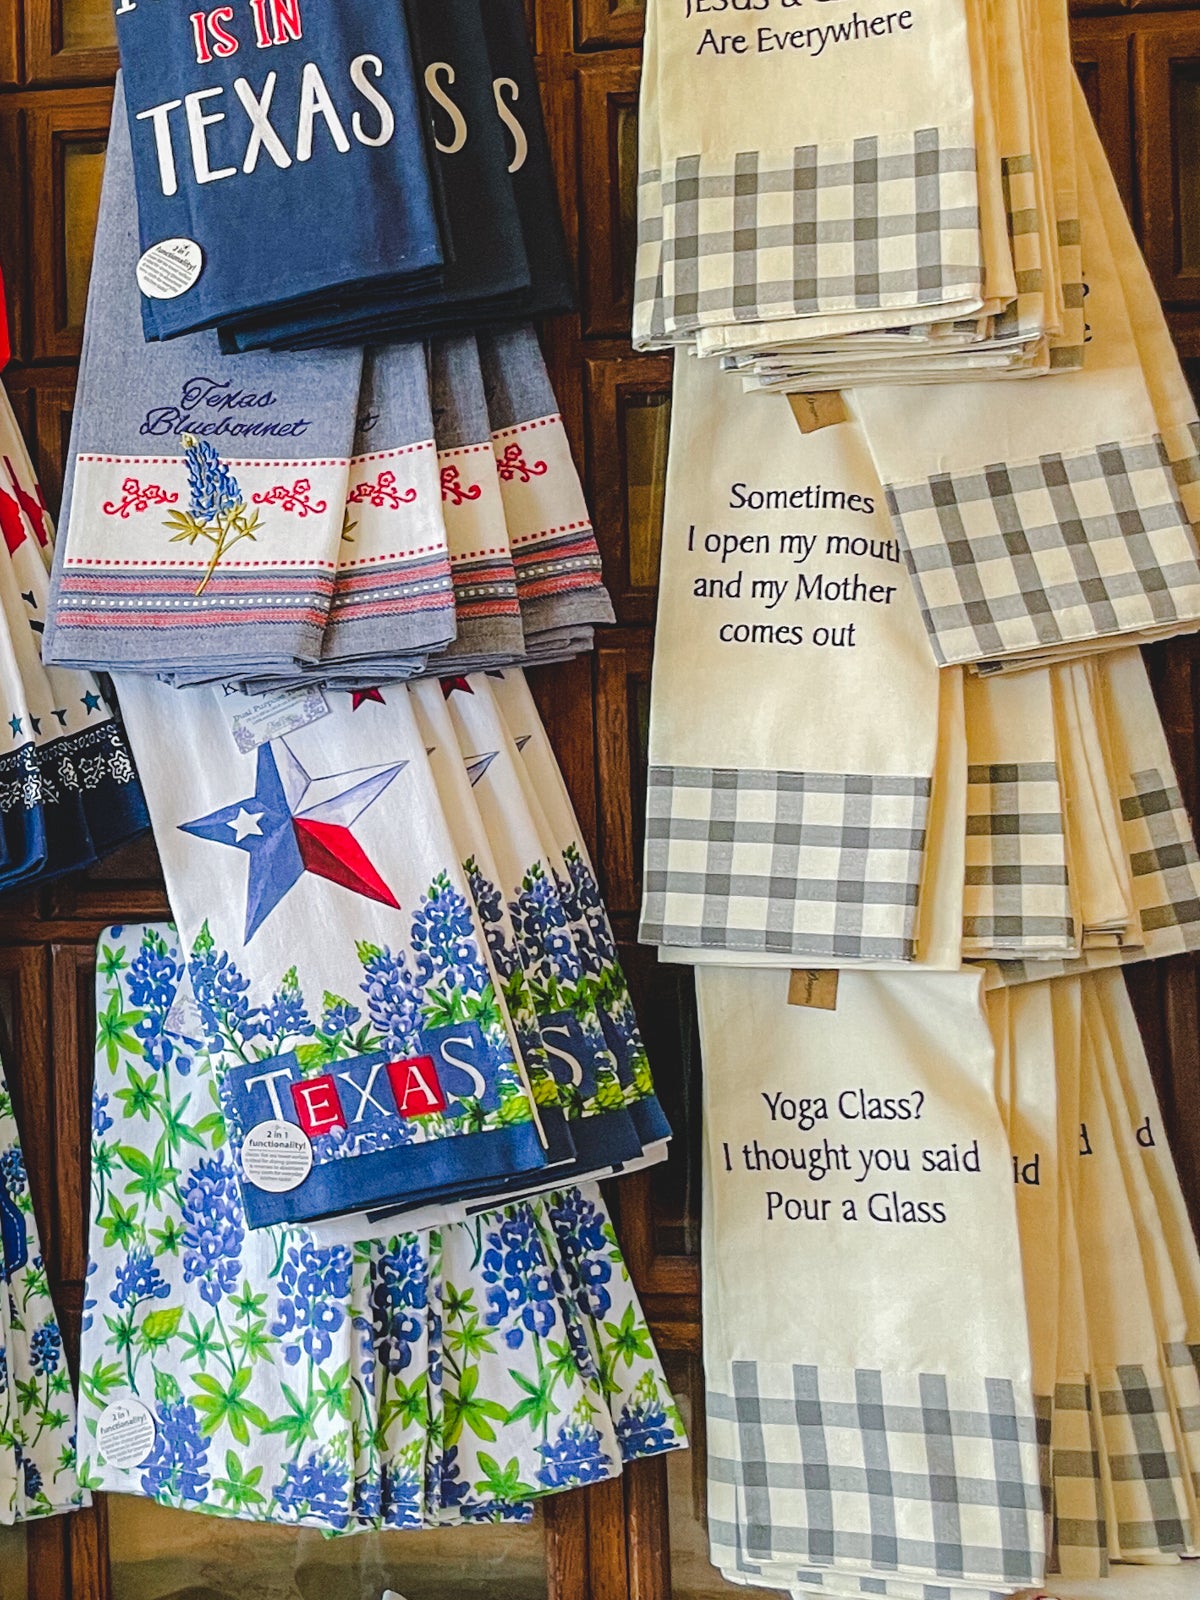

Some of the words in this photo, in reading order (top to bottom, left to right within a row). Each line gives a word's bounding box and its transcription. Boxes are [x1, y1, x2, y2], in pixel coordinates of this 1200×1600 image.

[190, 7, 239, 63] IS
[250, 0, 302, 47] IN
[696, 29, 747, 55] Are
[757, 10, 913, 56] Everywhere
[136, 54, 395, 196] TEXAS
[181, 377, 276, 411] Texas
[140, 407, 312, 438] Bluebonnet
[729, 483, 874, 514] Sometimes
[687, 525, 695, 551] I
[704, 534, 769, 563] open
[780, 535, 817, 563] my
[693, 571, 743, 598] and
[751, 580, 789, 608] my
[795, 573, 897, 604] Mother
[719, 623, 803, 645] comes
[813, 623, 856, 647] out
[245, 1036, 486, 1127] TEXAS
[761, 1092, 829, 1131] Yoga
[838, 1090, 925, 1121] Class?
[249, 1139, 306, 1151] functionality!
[722, 1142, 732, 1172] I
[742, 1139, 853, 1181] thought
[858, 1147, 912, 1182] you
[922, 1140, 982, 1173] said
[766, 1192, 831, 1222] Pour
[842, 1198, 858, 1222] a
[869, 1192, 947, 1224] Glass
